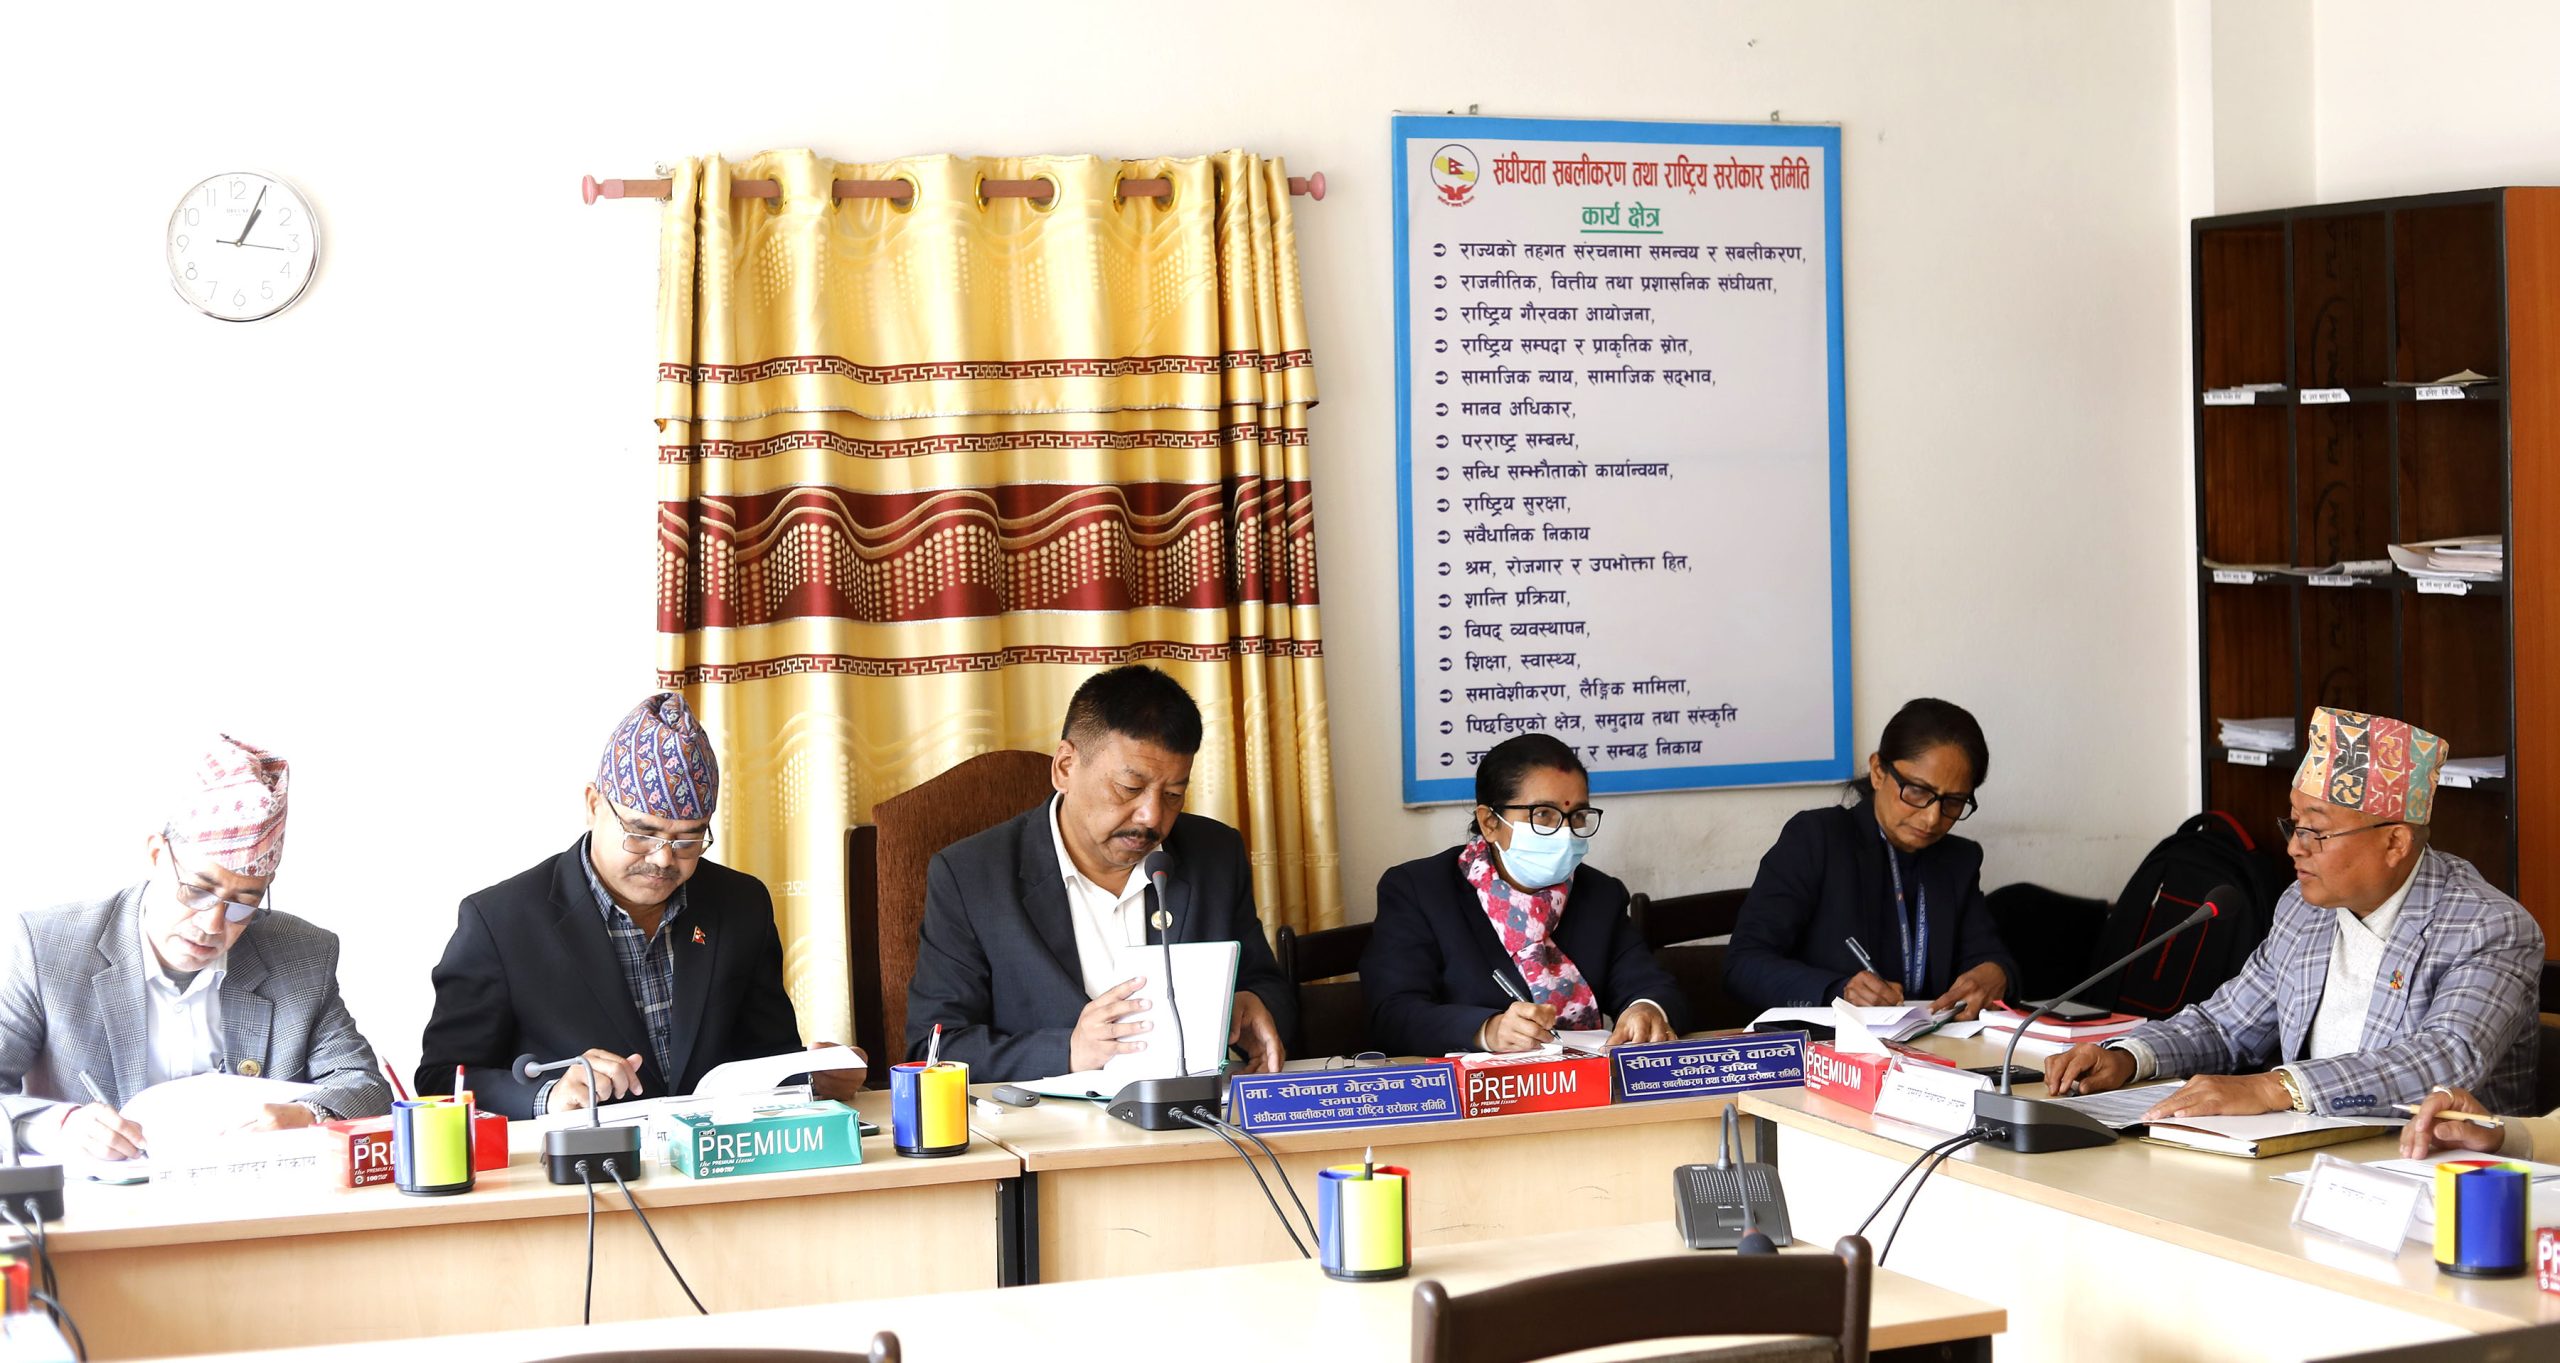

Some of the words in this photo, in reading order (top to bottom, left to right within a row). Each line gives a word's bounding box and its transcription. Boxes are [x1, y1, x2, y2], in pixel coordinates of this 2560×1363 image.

[1493, 152, 1546, 185] संघीयता
[1553, 153, 1627, 187] सबलीकरण
[1633, 162, 1658, 187] तथा
[1664, 154, 1708, 194] राष्ट्रिय
[1714, 156, 1764, 190] सरोकार
[1770, 156, 1810, 190] समिति
[206, 188, 216, 207] 11
[229, 180, 246, 200] 12
[184, 207, 200, 226] 10
[279, 207, 292, 226] 2
[1583, 202, 1620, 225] कार्य
[1629, 202, 1660, 228] क्षेत्र
[176, 234, 190, 253] 9
[287, 233, 300, 253] 3
[1459, 240, 1517, 259] राज्यको
[1524, 244, 1566, 260] तहगत
[1573, 242, 1642, 261] संरचनामा
[1649, 246, 1700, 260] समन्वय
[1707, 246, 1718, 262] र
[1725, 242, 1805, 262] सबलीकरण,
[185, 262, 198, 280] 8
[280, 261, 291, 279] 4
[207, 280, 218, 300] 7
[260, 280, 274, 300] 5
[1460, 270, 1541, 292] राजनीतिक,
[1551, 271, 1598, 290] वित्तीय
[1605, 276, 1633, 289] तथा
[1640, 272, 1711, 292] प्रशासनिक
[1718, 273, 1776, 293] संघीयता,
[232, 288, 246, 307] 6
[1460, 302, 1513, 326] राष्ट्रिय
[1520, 301, 1578, 323] गौरवका
[1586, 304, 1654, 323] आयोजना,
[1461, 334, 1513, 358] राष्ट्रिय
[1521, 339, 1567, 355] सम्पदा
[1574, 339, 1585, 355] र
[1592, 334, 1653, 358] प्राकृतिक
[1461, 365, 1531, 385] सामाजिक
[1538, 370, 1577, 386] न्याय,
[1587, 365, 1655, 385] सामाजिक
[1461, 402, 1502, 415] मानव
[1510, 397, 1575, 418] अधिकार,
[1462, 434, 1518, 453] परराष्ट्र
[1526, 433, 1578, 449] सम्बन्ध,
[1462, 460, 1500, 481] सन्धि
[1507, 459, 1588, 480] सम्झौताको
[1595, 459, 1673, 479] कार्यान्वयन,
[1462, 492, 1515, 517] राष्ट्रिय
[1523, 496, 1570, 516] सुरक्षा,
[1464, 523, 1535, 544] संवैधानिक
[1542, 523, 1591, 541] निकाय
[1466, 561, 1496, 577] श्रम,
[1505, 556, 1563, 576] रोजगार
[1570, 559, 1582, 574] र
[1589, 554, 1655, 572] उपभोक्ता
[1662, 551, 1691, 572] हित,
[1464, 587, 1508, 608] शान्ति
[1515, 586, 1570, 607] प्रक्रिया,
[1464, 620, 1504, 641] विपद्
[1510, 621, 1590, 637] व्यवस्थापन,
[1465, 651, 1511, 672] शिक्षा,
[1520, 653, 1580, 669] स्वास्थ्य,
[1465, 681, 1570, 703] समावेशीकरण,
[1579, 677, 1625, 700] लैङ्गिक
[1632, 675, 1690, 696] मामिला,
[1555, 712, 1585, 731] क्षेत्र,
[1594, 712, 1645, 733] समुदाय
[1652, 711, 1680, 725] तथा
[1687, 703, 1738, 728] संस्कृति
[1587, 746, 1600, 762] र
[1606, 743, 1649, 760] सम्बद्ध
[1655, 737, 1703, 756] निकाय
[1626, 1055, 1672, 1070] सीता
[1678, 1048, 1741, 1066] काफ्ले
[1746, 1044, 1796, 1059] वाग्ले
[1670, 1065, 1715, 1078] समिति
[1720, 1061, 1758, 1073] सचिव
[1807, 1051, 1862, 1090] PREMIUM
[1245, 1088, 1273, 1100] मा.
[1278, 1082, 1338, 1099] सोनाम
[1344, 1077, 1405, 1094] गेल्जेन
[1411, 1073, 1446, 1090] शेर्पा
[1469, 1070, 1576, 1102] PREMIUM
[1630, 1080, 1660, 1092] संघीयता
[1662, 1077, 1703, 1089] सबलीकरण
[1705, 1076, 1720, 1085] तथा
[1721, 1072, 1746, 1085] राष्ट्रिय
[1747, 1070, 1776, 1081] सरोकार
[1253, 1108, 1287, 1123] संघीयता
[1289, 1106, 1336, 1121] सबलीकरण
[1338, 1107, 1354, 1118] तथा
[1356, 1103, 1384, 1118] राष्ट्रिय
[1387, 1101, 1418, 1114] सरोकार
[1421, 1098, 1446, 1111] समिति
[1319, 1094, 1379, 1107] सभापति
[699, 1125, 824, 1161] PREMIUM
